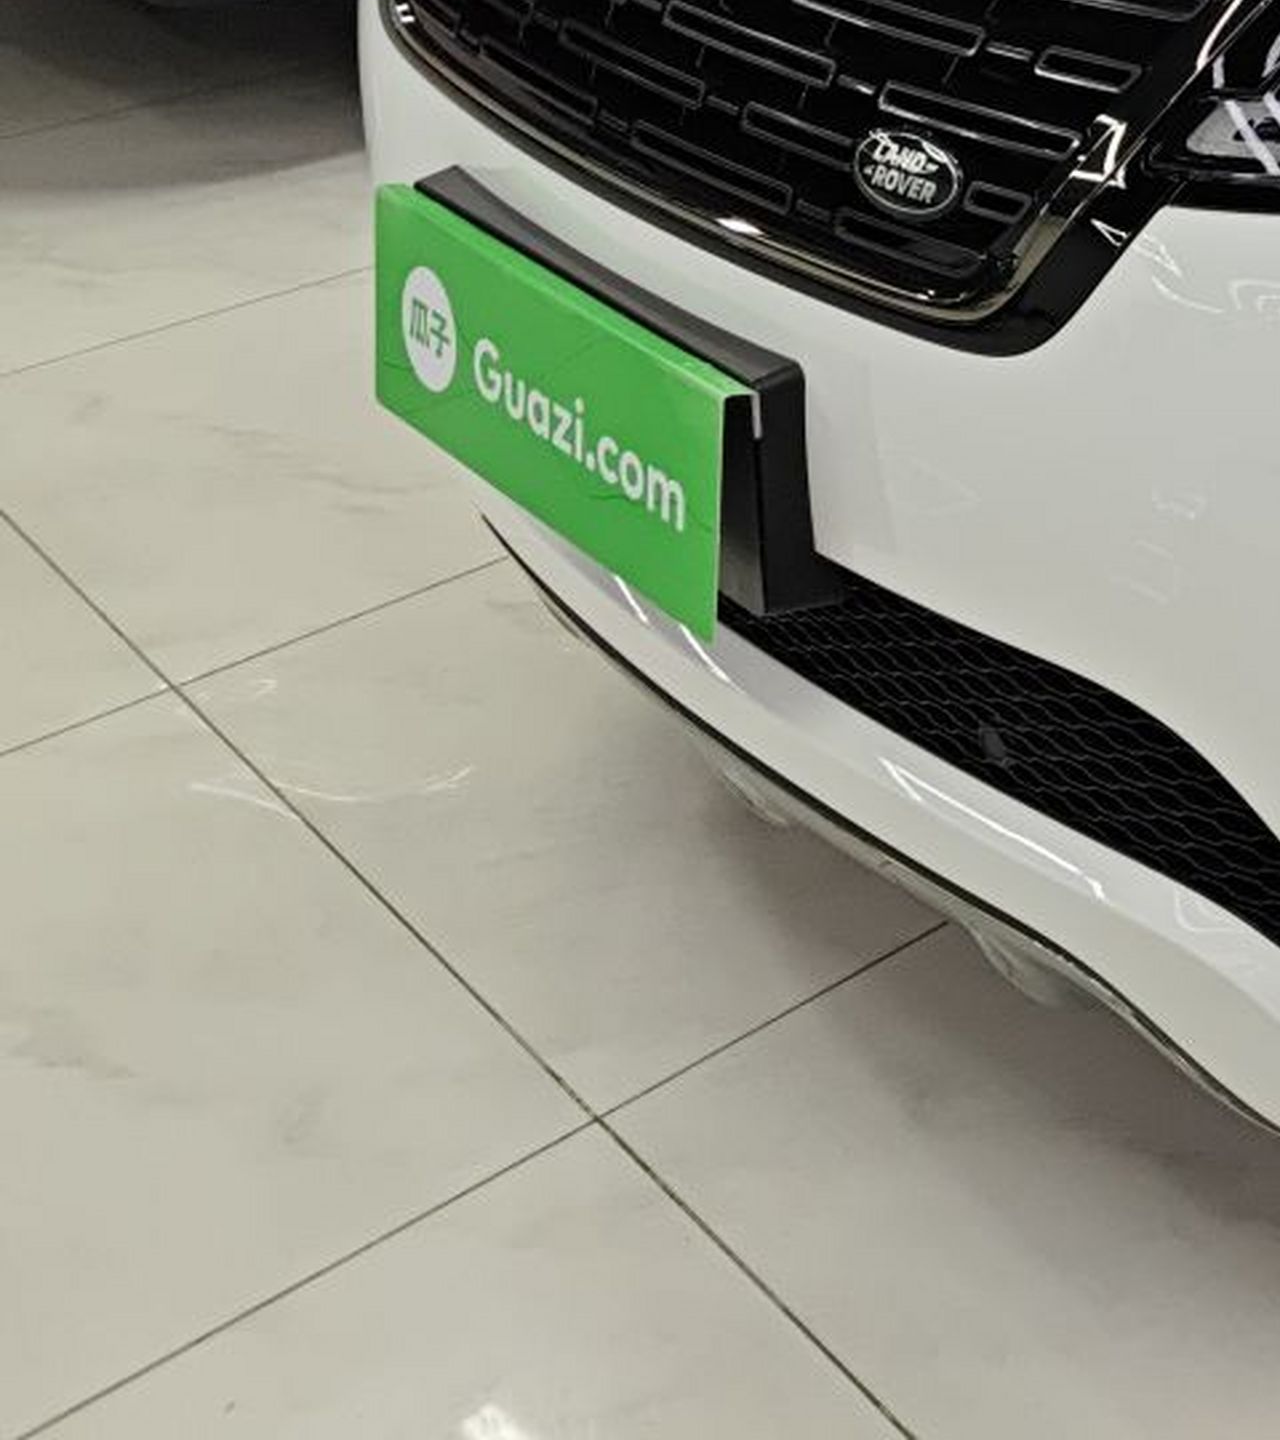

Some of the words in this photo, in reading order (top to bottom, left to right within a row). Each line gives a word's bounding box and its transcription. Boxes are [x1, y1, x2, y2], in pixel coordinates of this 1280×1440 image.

[873, 141, 928, 174] LAND
[871, 164, 937, 204] ROVER
[409, 297, 450, 359] 瓜子
[473, 338, 686, 533] Guazi.com
